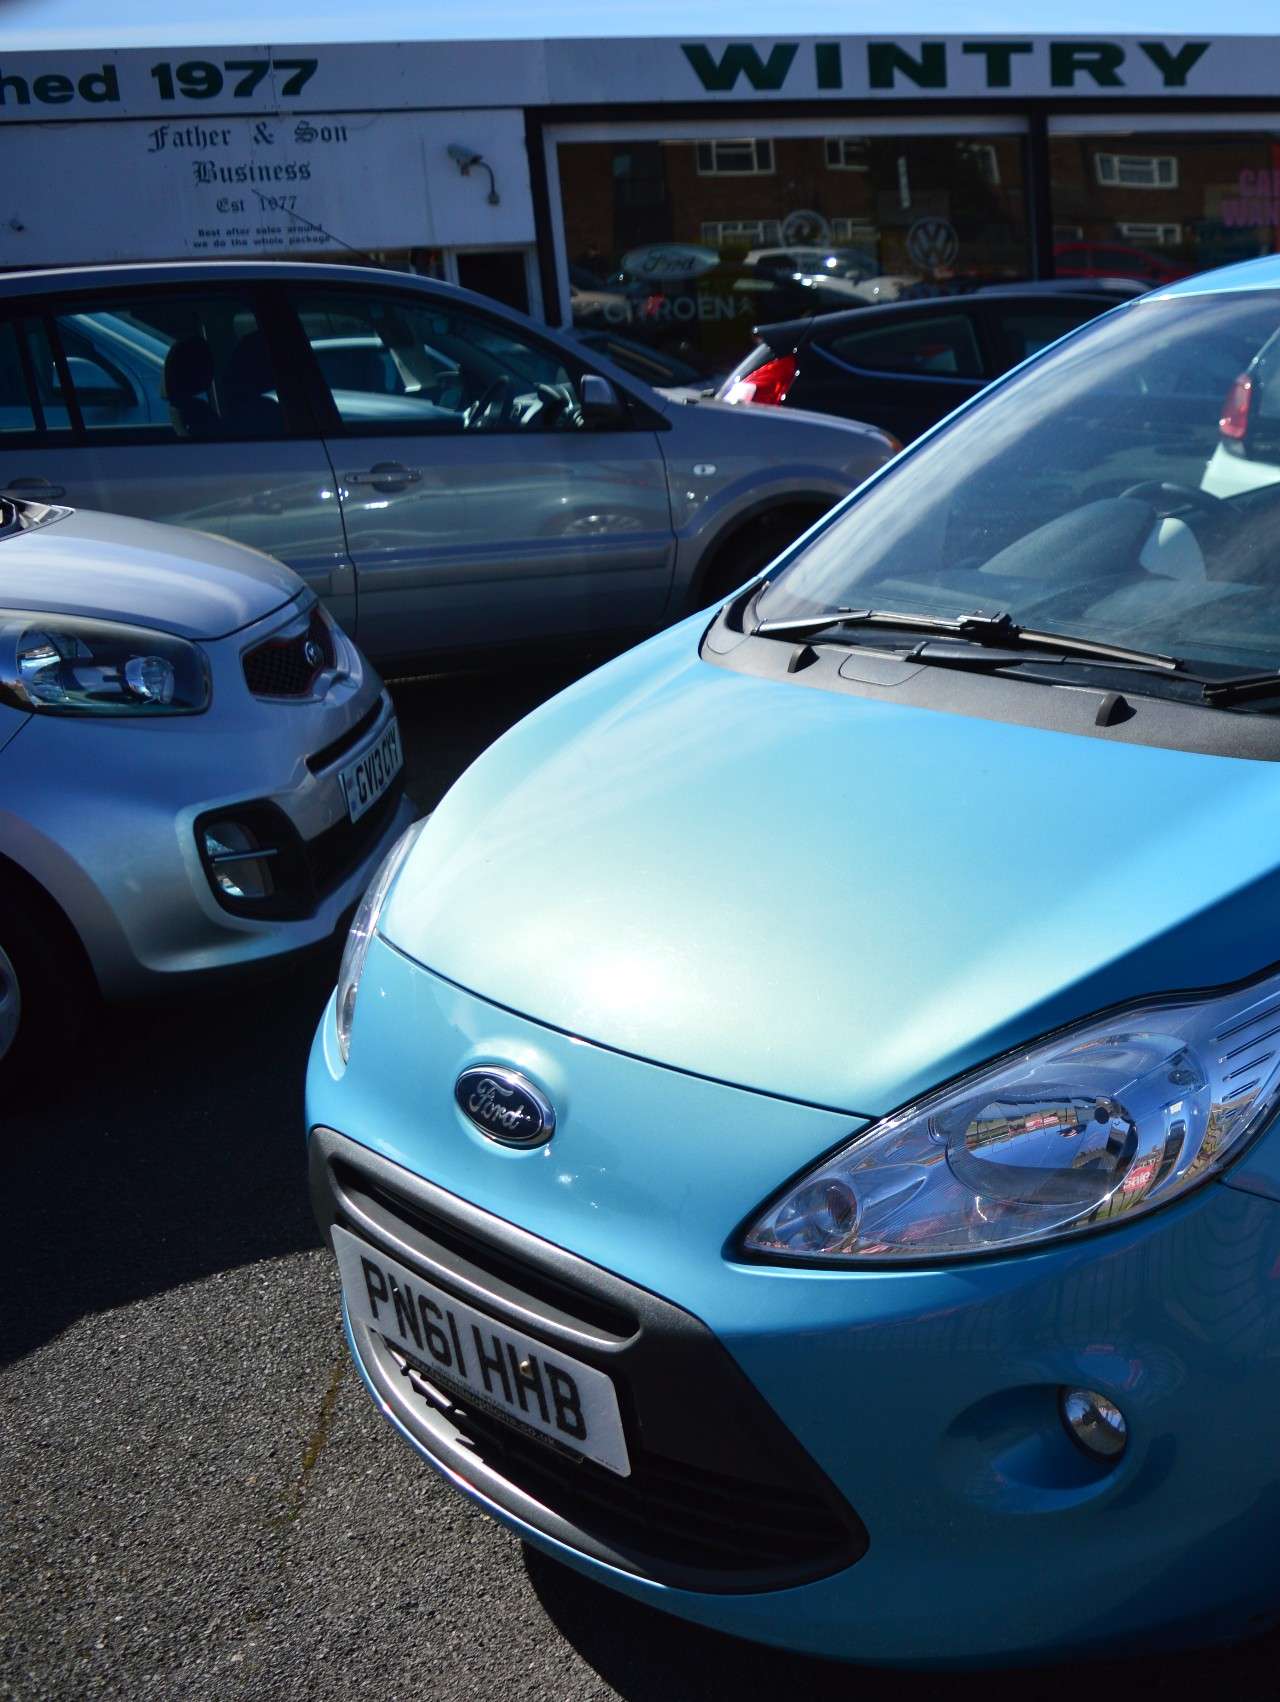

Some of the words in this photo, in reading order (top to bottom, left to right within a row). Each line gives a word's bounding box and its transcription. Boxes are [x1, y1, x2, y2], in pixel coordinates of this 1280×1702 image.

[150, 58, 319, 101] 1977
[680, 42, 1211, 91] WINTRY
[147, 125, 231, 153] Father
[253, 121, 274, 145] &
[294, 120, 348, 145] Son
[192, 160, 311, 187] Business
[216, 198, 244, 214] Est
[259, 196, 297, 211] 1977
[226, 226, 250, 236] after
[231, 237, 248, 247] the
[468, 1078, 531, 1131] Ford
[360, 1255, 468, 1379] PN61
[471, 1324, 588, 1441] HHB
